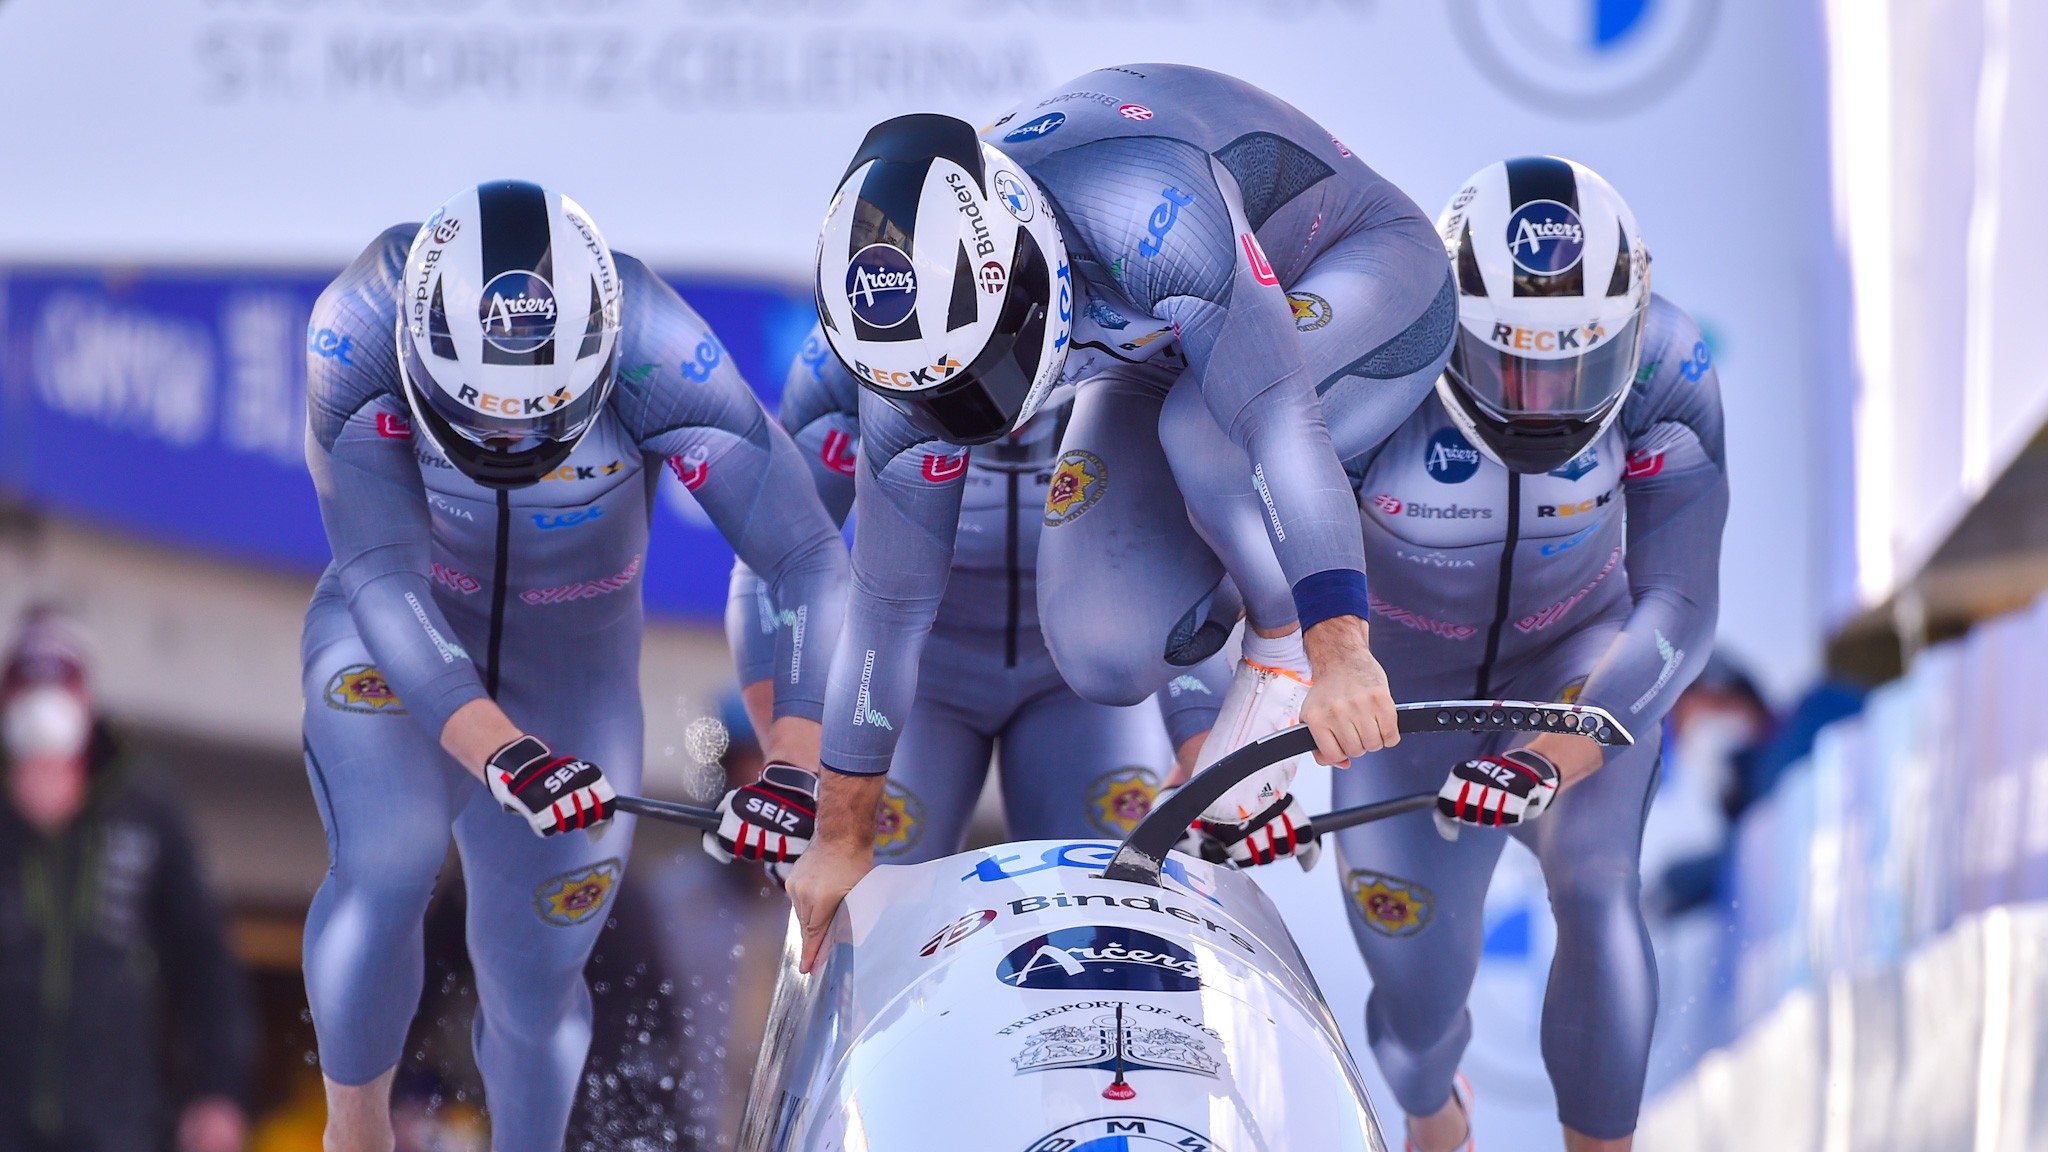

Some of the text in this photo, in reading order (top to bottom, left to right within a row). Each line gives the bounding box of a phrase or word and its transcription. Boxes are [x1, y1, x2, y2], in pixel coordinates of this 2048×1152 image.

[946, 173, 995, 258] Binders
[1138, 187, 1196, 259] tet
[566, 212, 613, 295] Binders
[414, 249, 442, 339] Binders
[531, 505, 606, 531] tet
[1406, 503, 1492, 519] Binders
[1397, 551, 1476, 568] LATVIJA
[544, 759, 591, 794] SEIZ
[745, 797, 801, 832] SEIZ
[1007, 893, 1256, 954] Binders
[996, 1000, 1226, 1042] FREEPORT OF RIG
